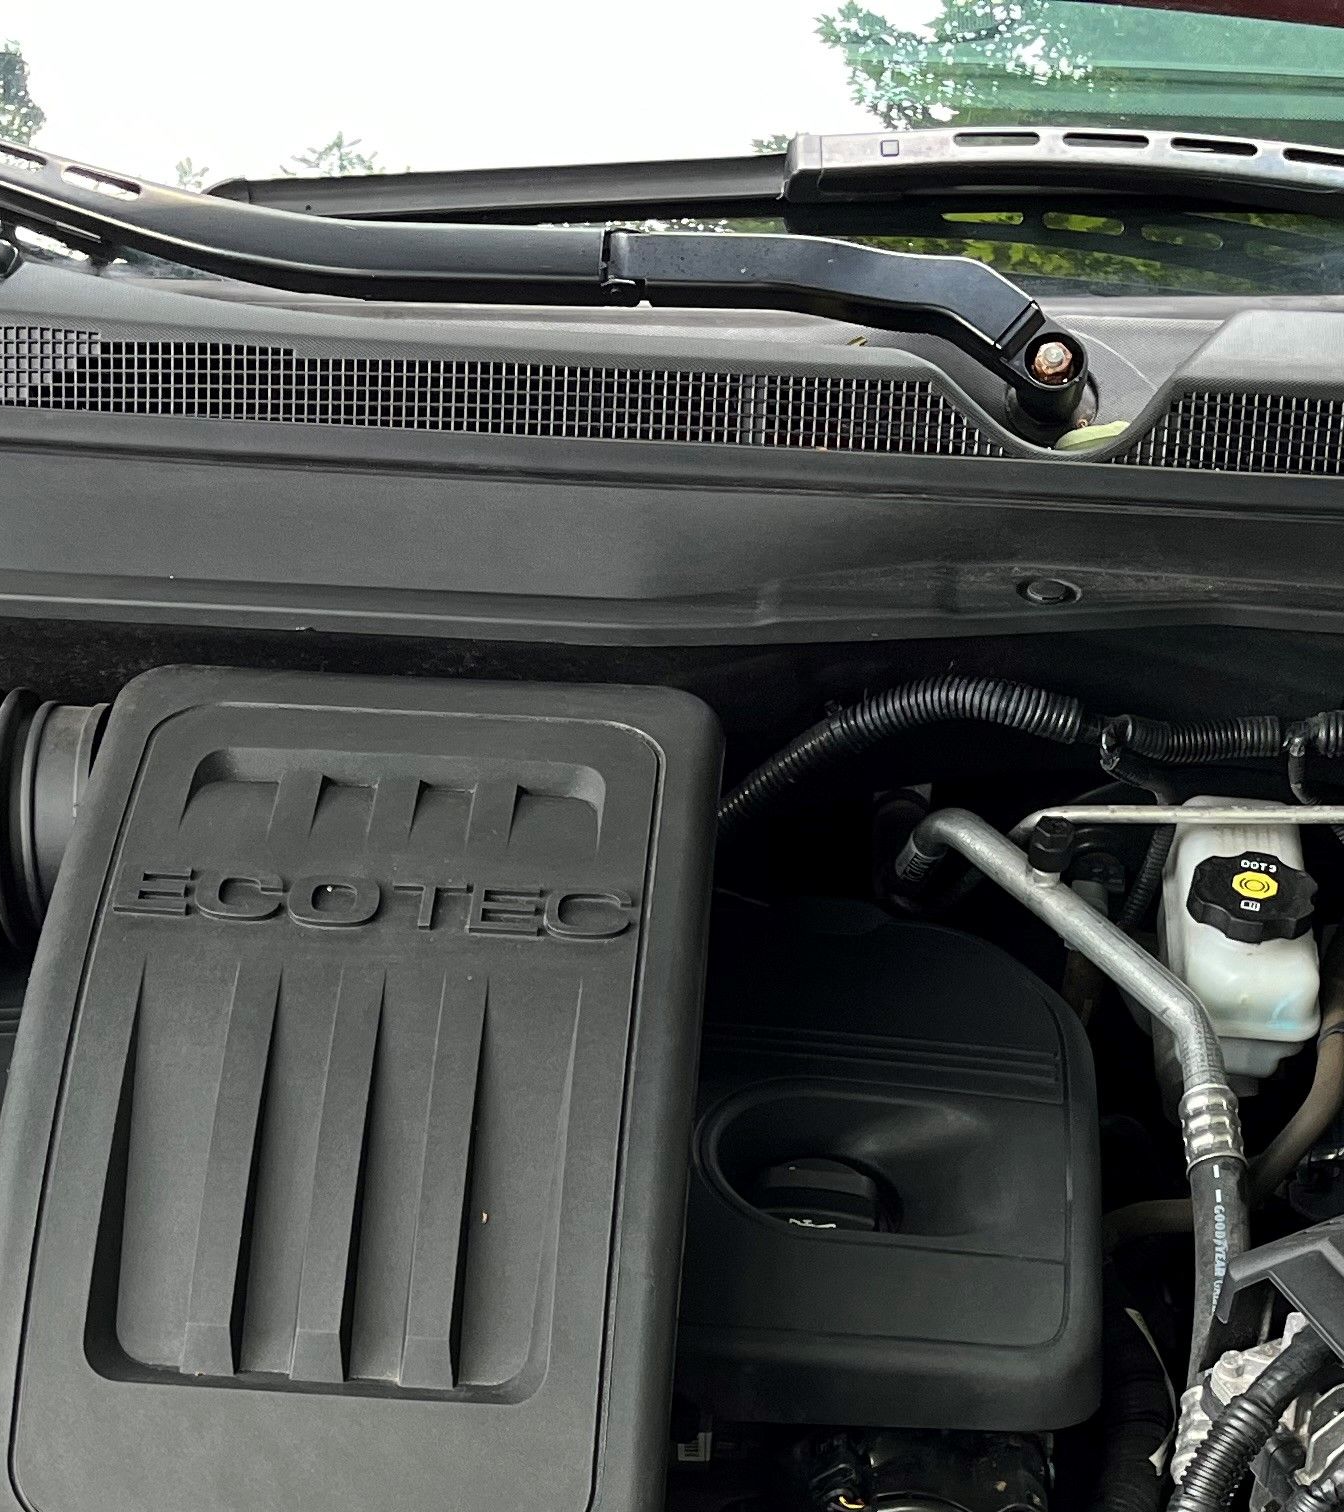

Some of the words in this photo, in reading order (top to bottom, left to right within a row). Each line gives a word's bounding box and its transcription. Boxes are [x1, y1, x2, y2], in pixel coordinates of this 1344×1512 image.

[1240, 859, 1267, 871] DOT
[1269, 864, 1277, 872] 3
[112, 867, 635, 940] ECOTEC
[1213, 1204, 1228, 1276] GOODYEAR
